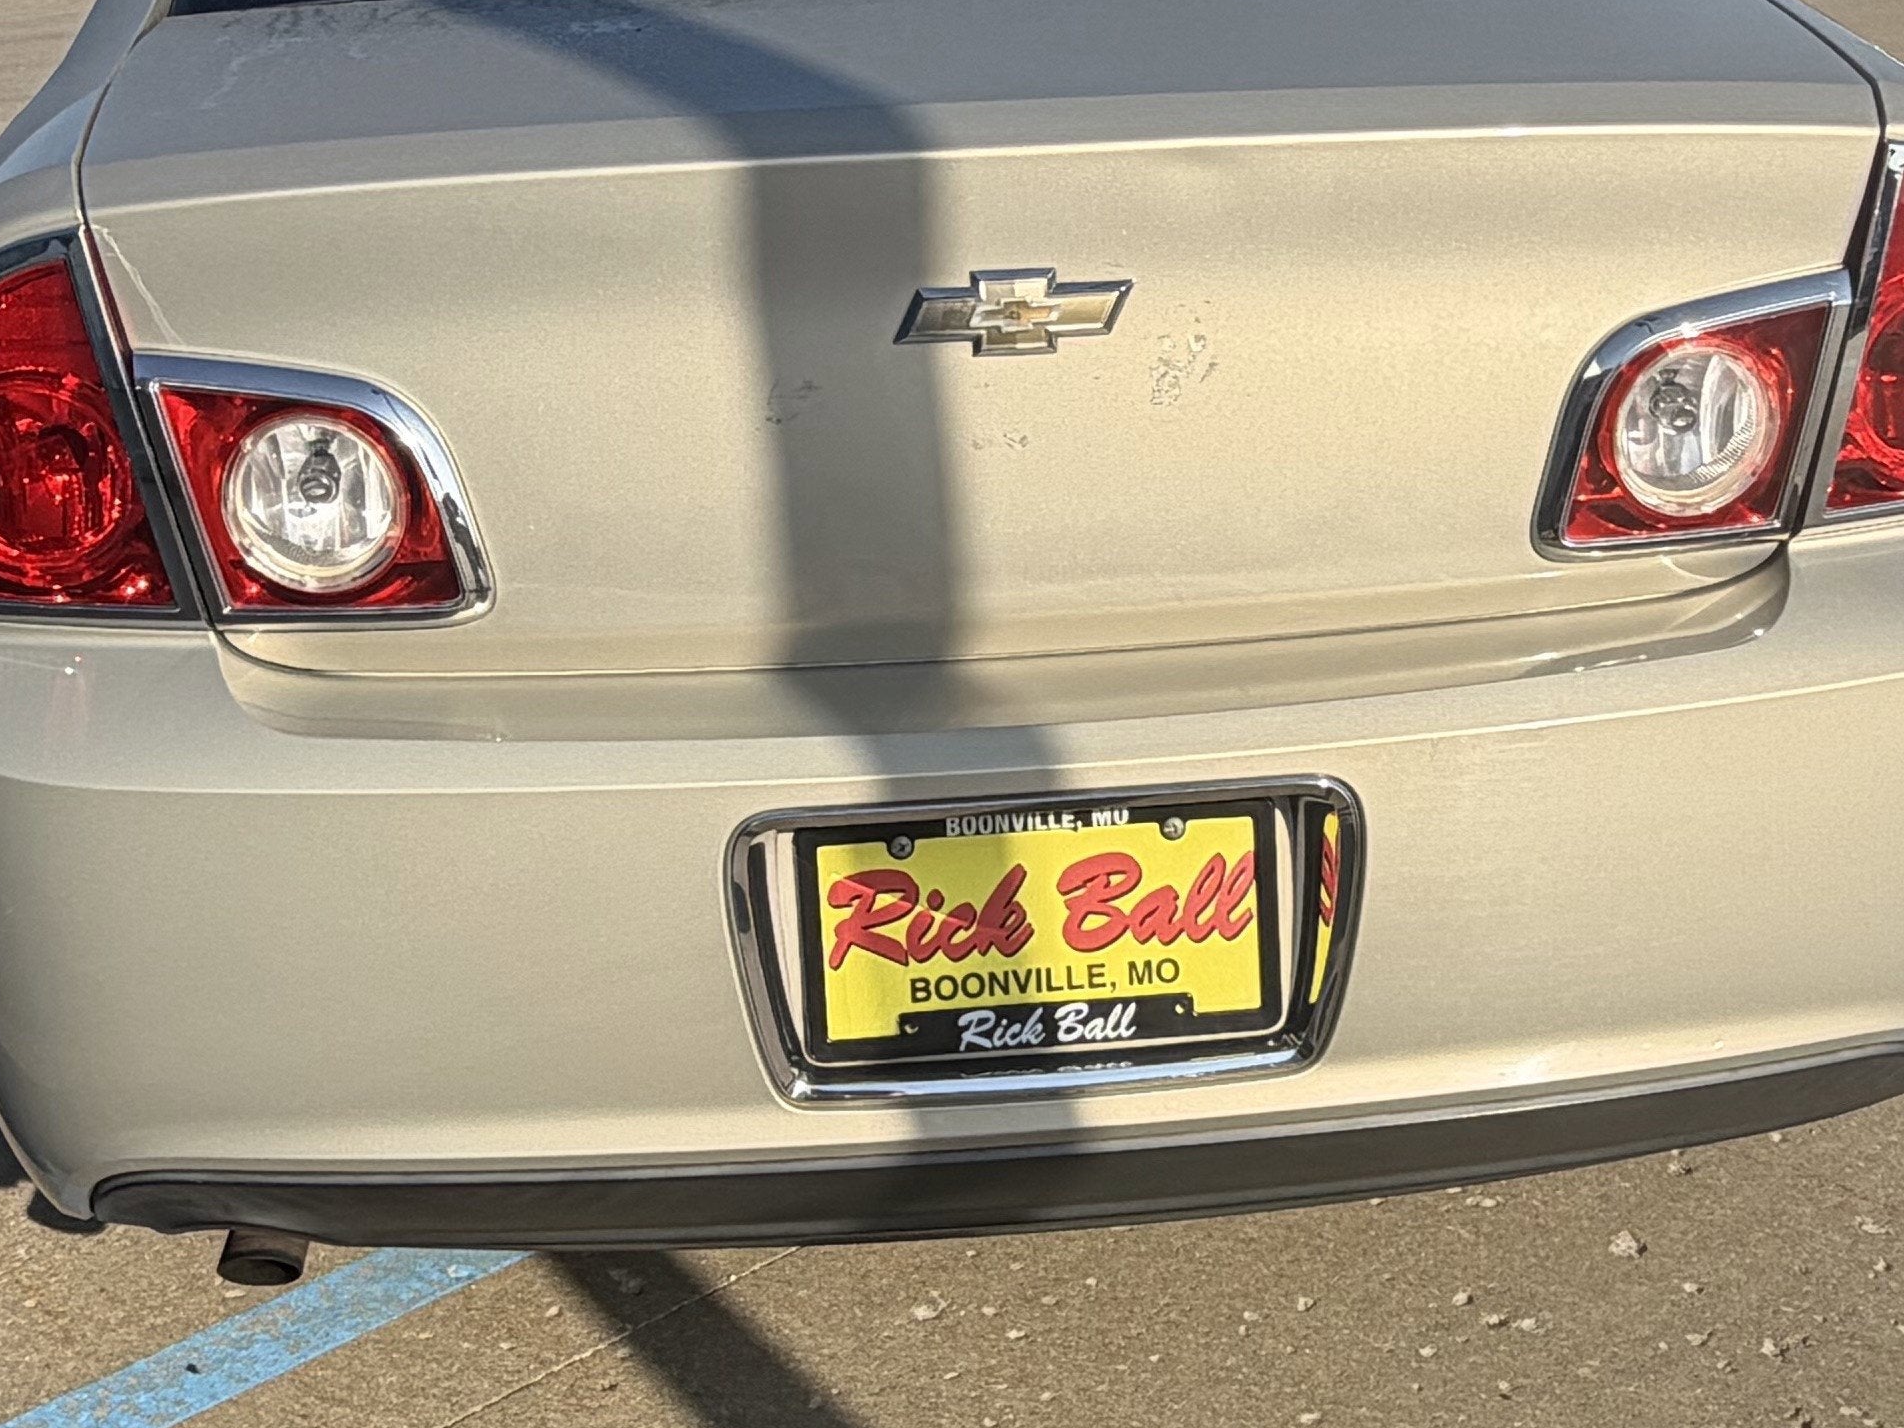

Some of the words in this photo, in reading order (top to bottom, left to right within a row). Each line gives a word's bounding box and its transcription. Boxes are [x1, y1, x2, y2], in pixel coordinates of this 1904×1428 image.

[946, 811, 1084, 837] BOONVILLE,
[827, 863, 1035, 971] Rick
[1056, 851, 1256, 953] Ball
[910, 962, 1119, 1004] BOONVILLE,
[1128, 958, 1181, 986] MO
[957, 1007, 1046, 1052] Rick
[1053, 1002, 1138, 1040] Ball
